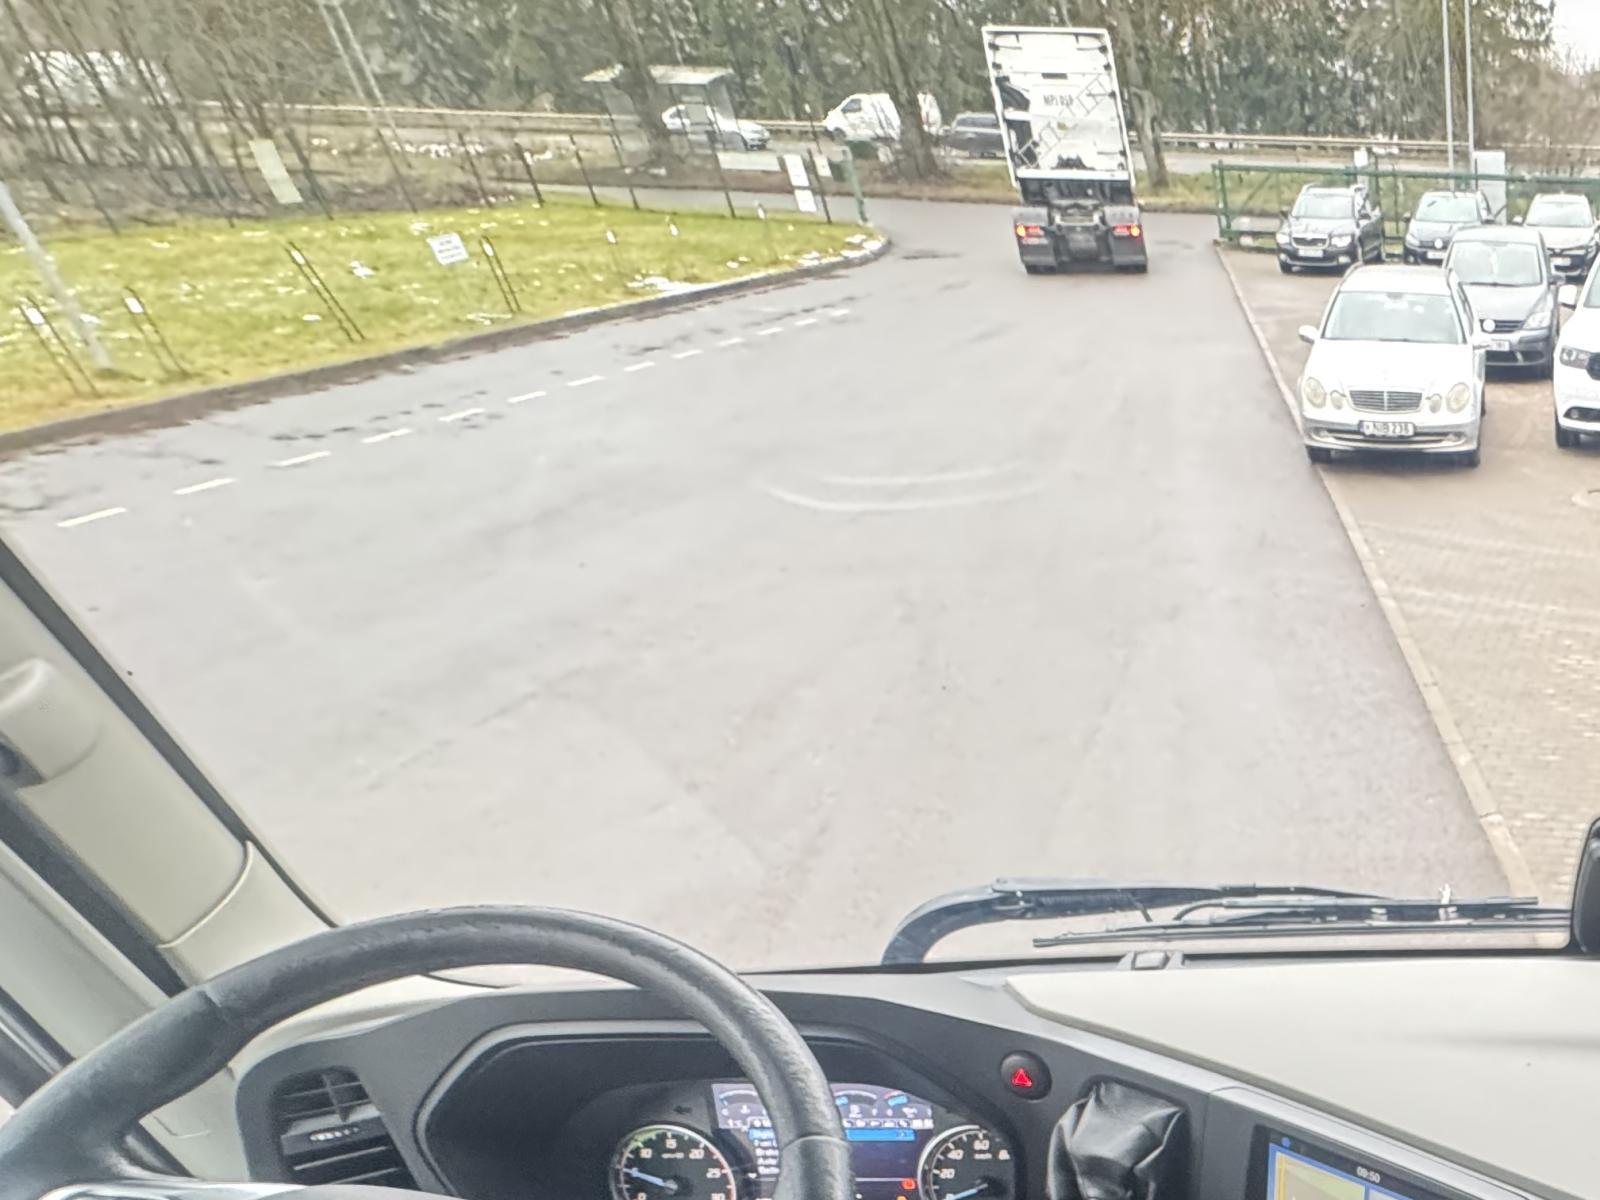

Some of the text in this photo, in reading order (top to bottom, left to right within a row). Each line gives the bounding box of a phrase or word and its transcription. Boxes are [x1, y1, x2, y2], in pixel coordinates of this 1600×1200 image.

[664, 1138, 677, 1149] 15
[973, 1138, 990, 1151] 60
[640, 1148, 653, 1159] 10
[688, 1148, 705, 1160] 20
[947, 1149, 964, 1160] 40
[706, 1168, 721, 1179] 25
[938, 1168, 955, 1180] 20
[1355, 1166, 1381, 1184] 09:50
